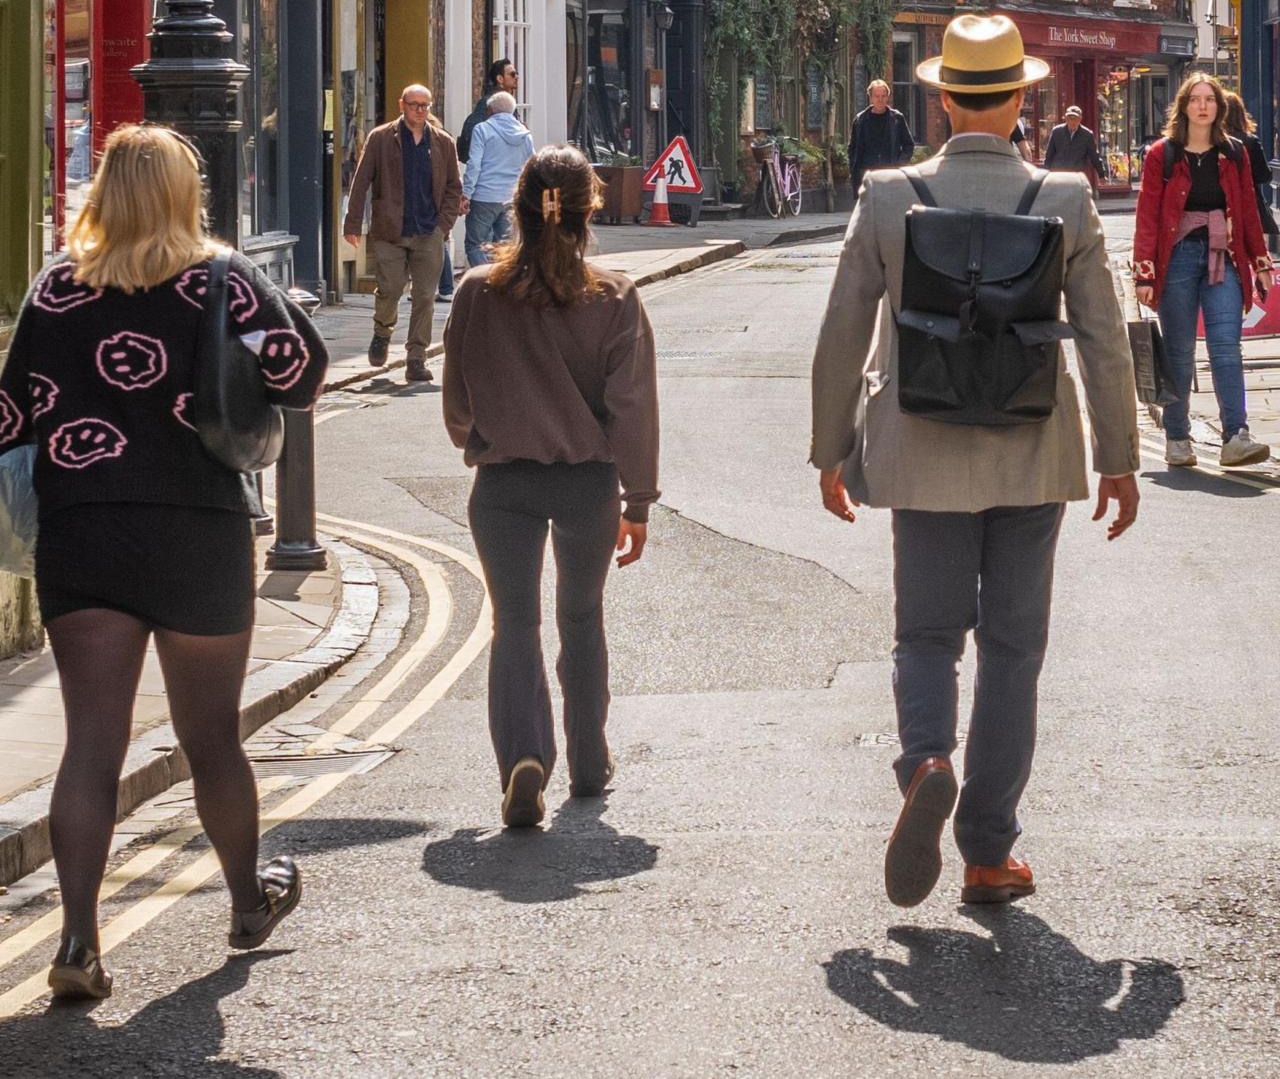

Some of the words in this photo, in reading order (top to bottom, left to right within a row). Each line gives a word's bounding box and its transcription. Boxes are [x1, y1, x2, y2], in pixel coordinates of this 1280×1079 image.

[1048, 26, 1062, 41] The
[1063, 28, 1080, 42] York
[1080, 31, 1099, 45] Sweet
[1099, 31, 1116, 48] Shop
